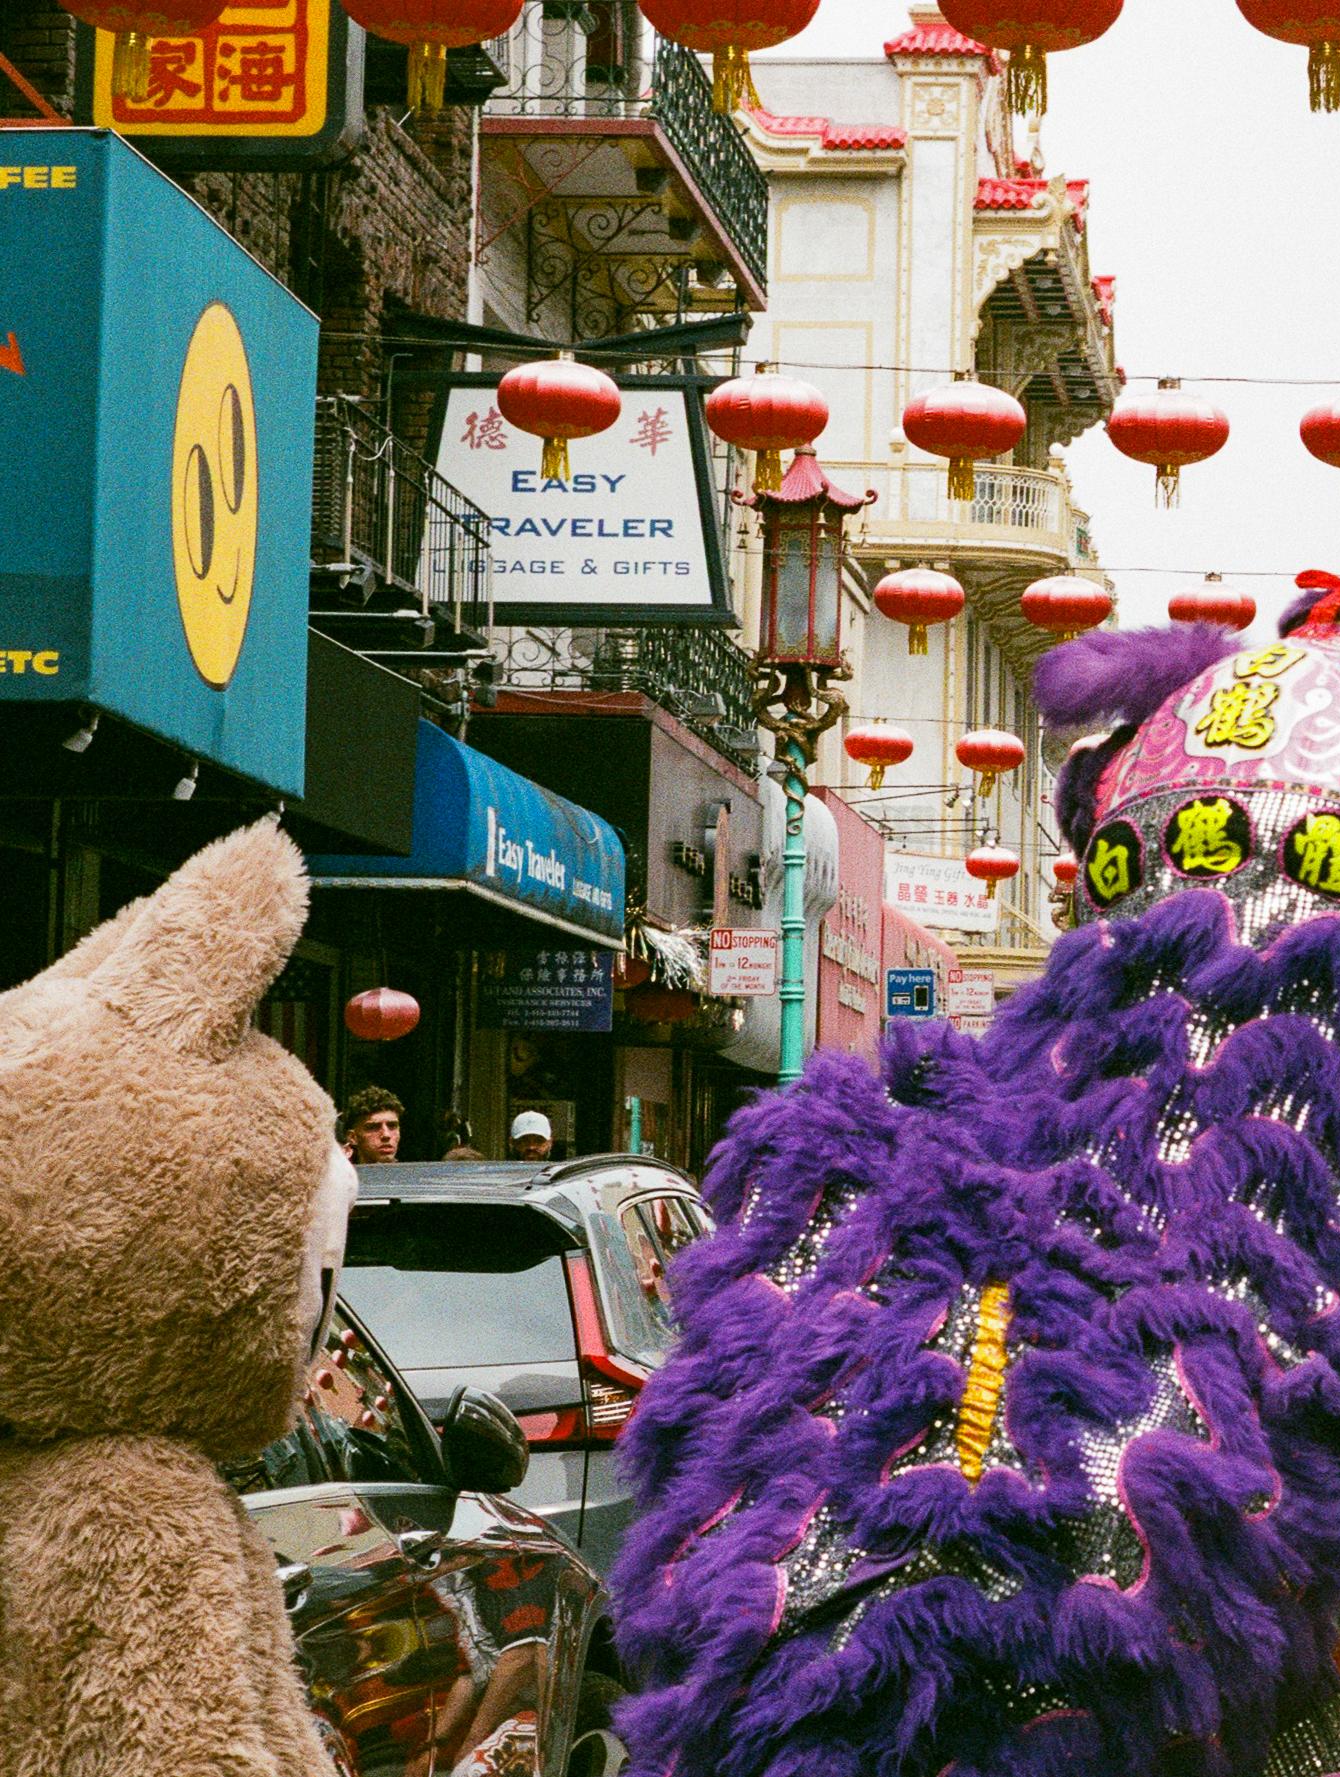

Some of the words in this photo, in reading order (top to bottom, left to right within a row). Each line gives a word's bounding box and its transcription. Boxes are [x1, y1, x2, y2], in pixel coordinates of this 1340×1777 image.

[0, 166, 76, 189] FEE
[511, 470, 626, 493] EASY
[581, 559, 598, 575] &
[613, 561, 691, 576] GIFTS
[0, 650, 59, 675] TC
[498, 826, 525, 884] Easy
[525, 839, 566, 891] Traveler
[713, 931, 731, 948] NO
[732, 936, 776, 948] STOPPING
[889, 974, 908, 985] Pay
[909, 974, 931, 983] here
